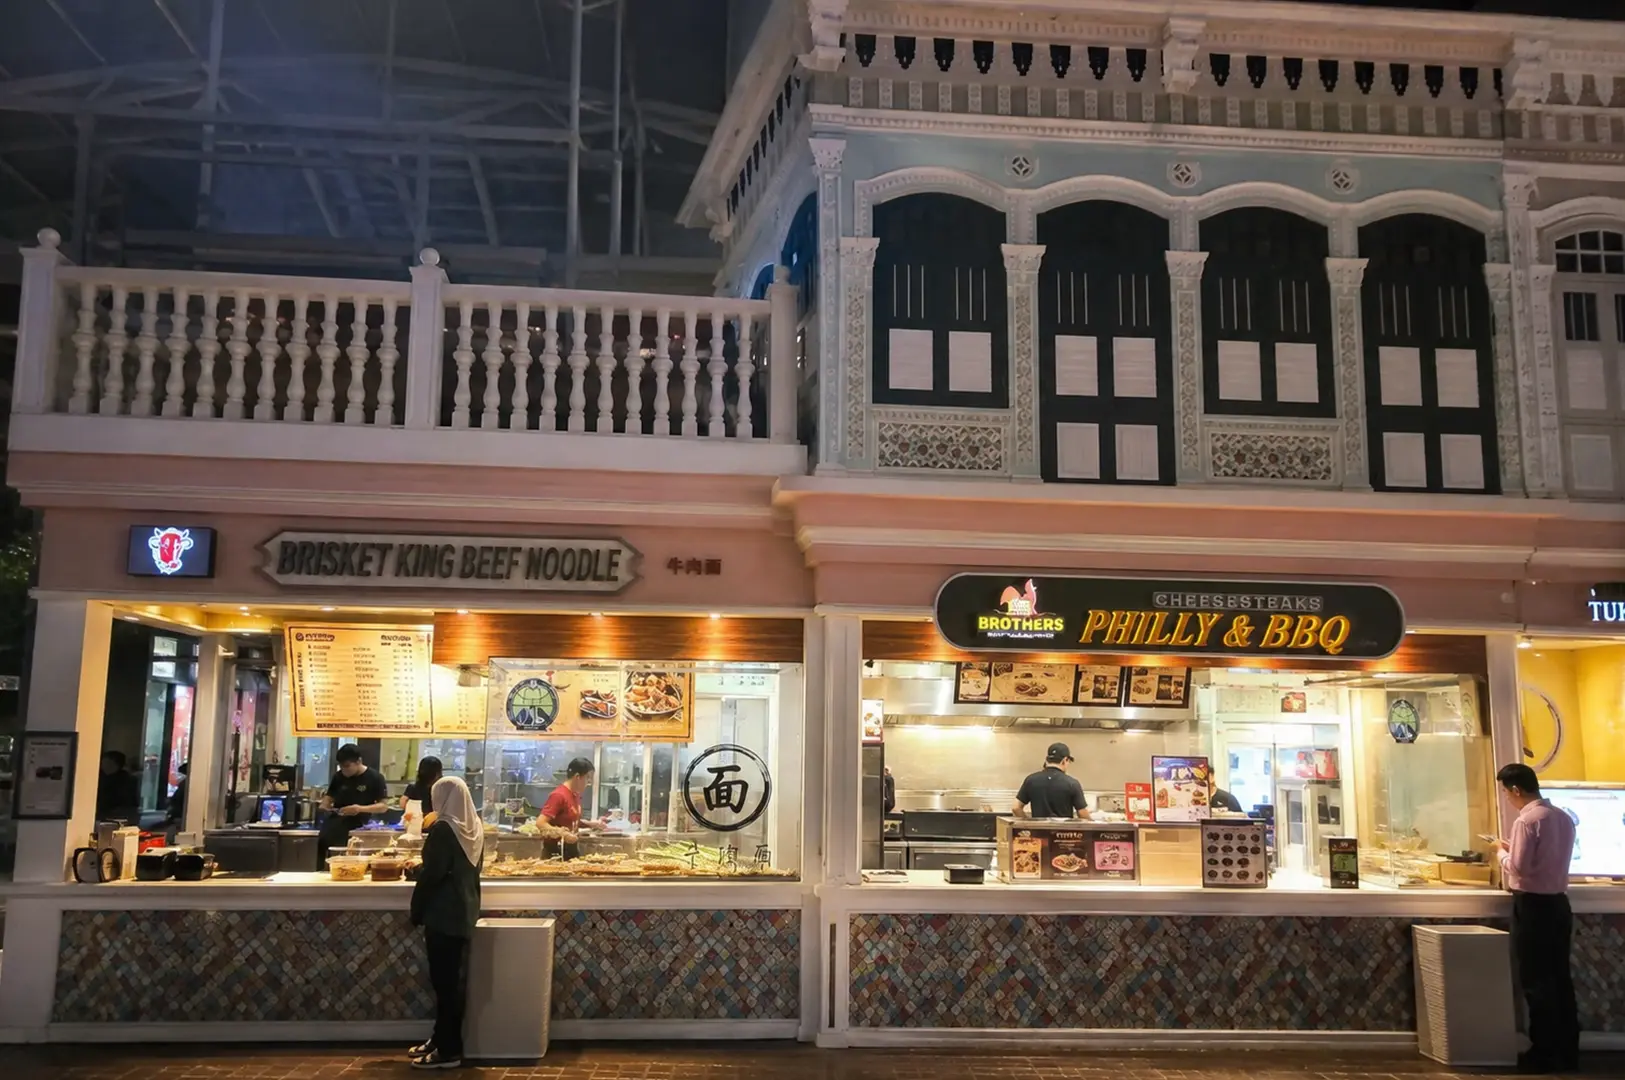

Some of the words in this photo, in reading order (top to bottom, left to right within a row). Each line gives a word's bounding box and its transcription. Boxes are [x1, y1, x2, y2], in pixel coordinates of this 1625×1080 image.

[276, 540, 394, 577] BRISKET
[394, 543, 456, 579] KING
[459, 545, 522, 580] BEEF
[525, 547, 622, 582] NOODLE
[1154, 593, 1322, 611] CHEESESTEAKS
[978, 616, 1064, 632] BROTHERS
[1078, 609, 1224, 647] PHILLY
[1223, 614, 1255, 648] &
[1259, 614, 1351, 655] BBQ
[703, 764, 749, 814] 面
